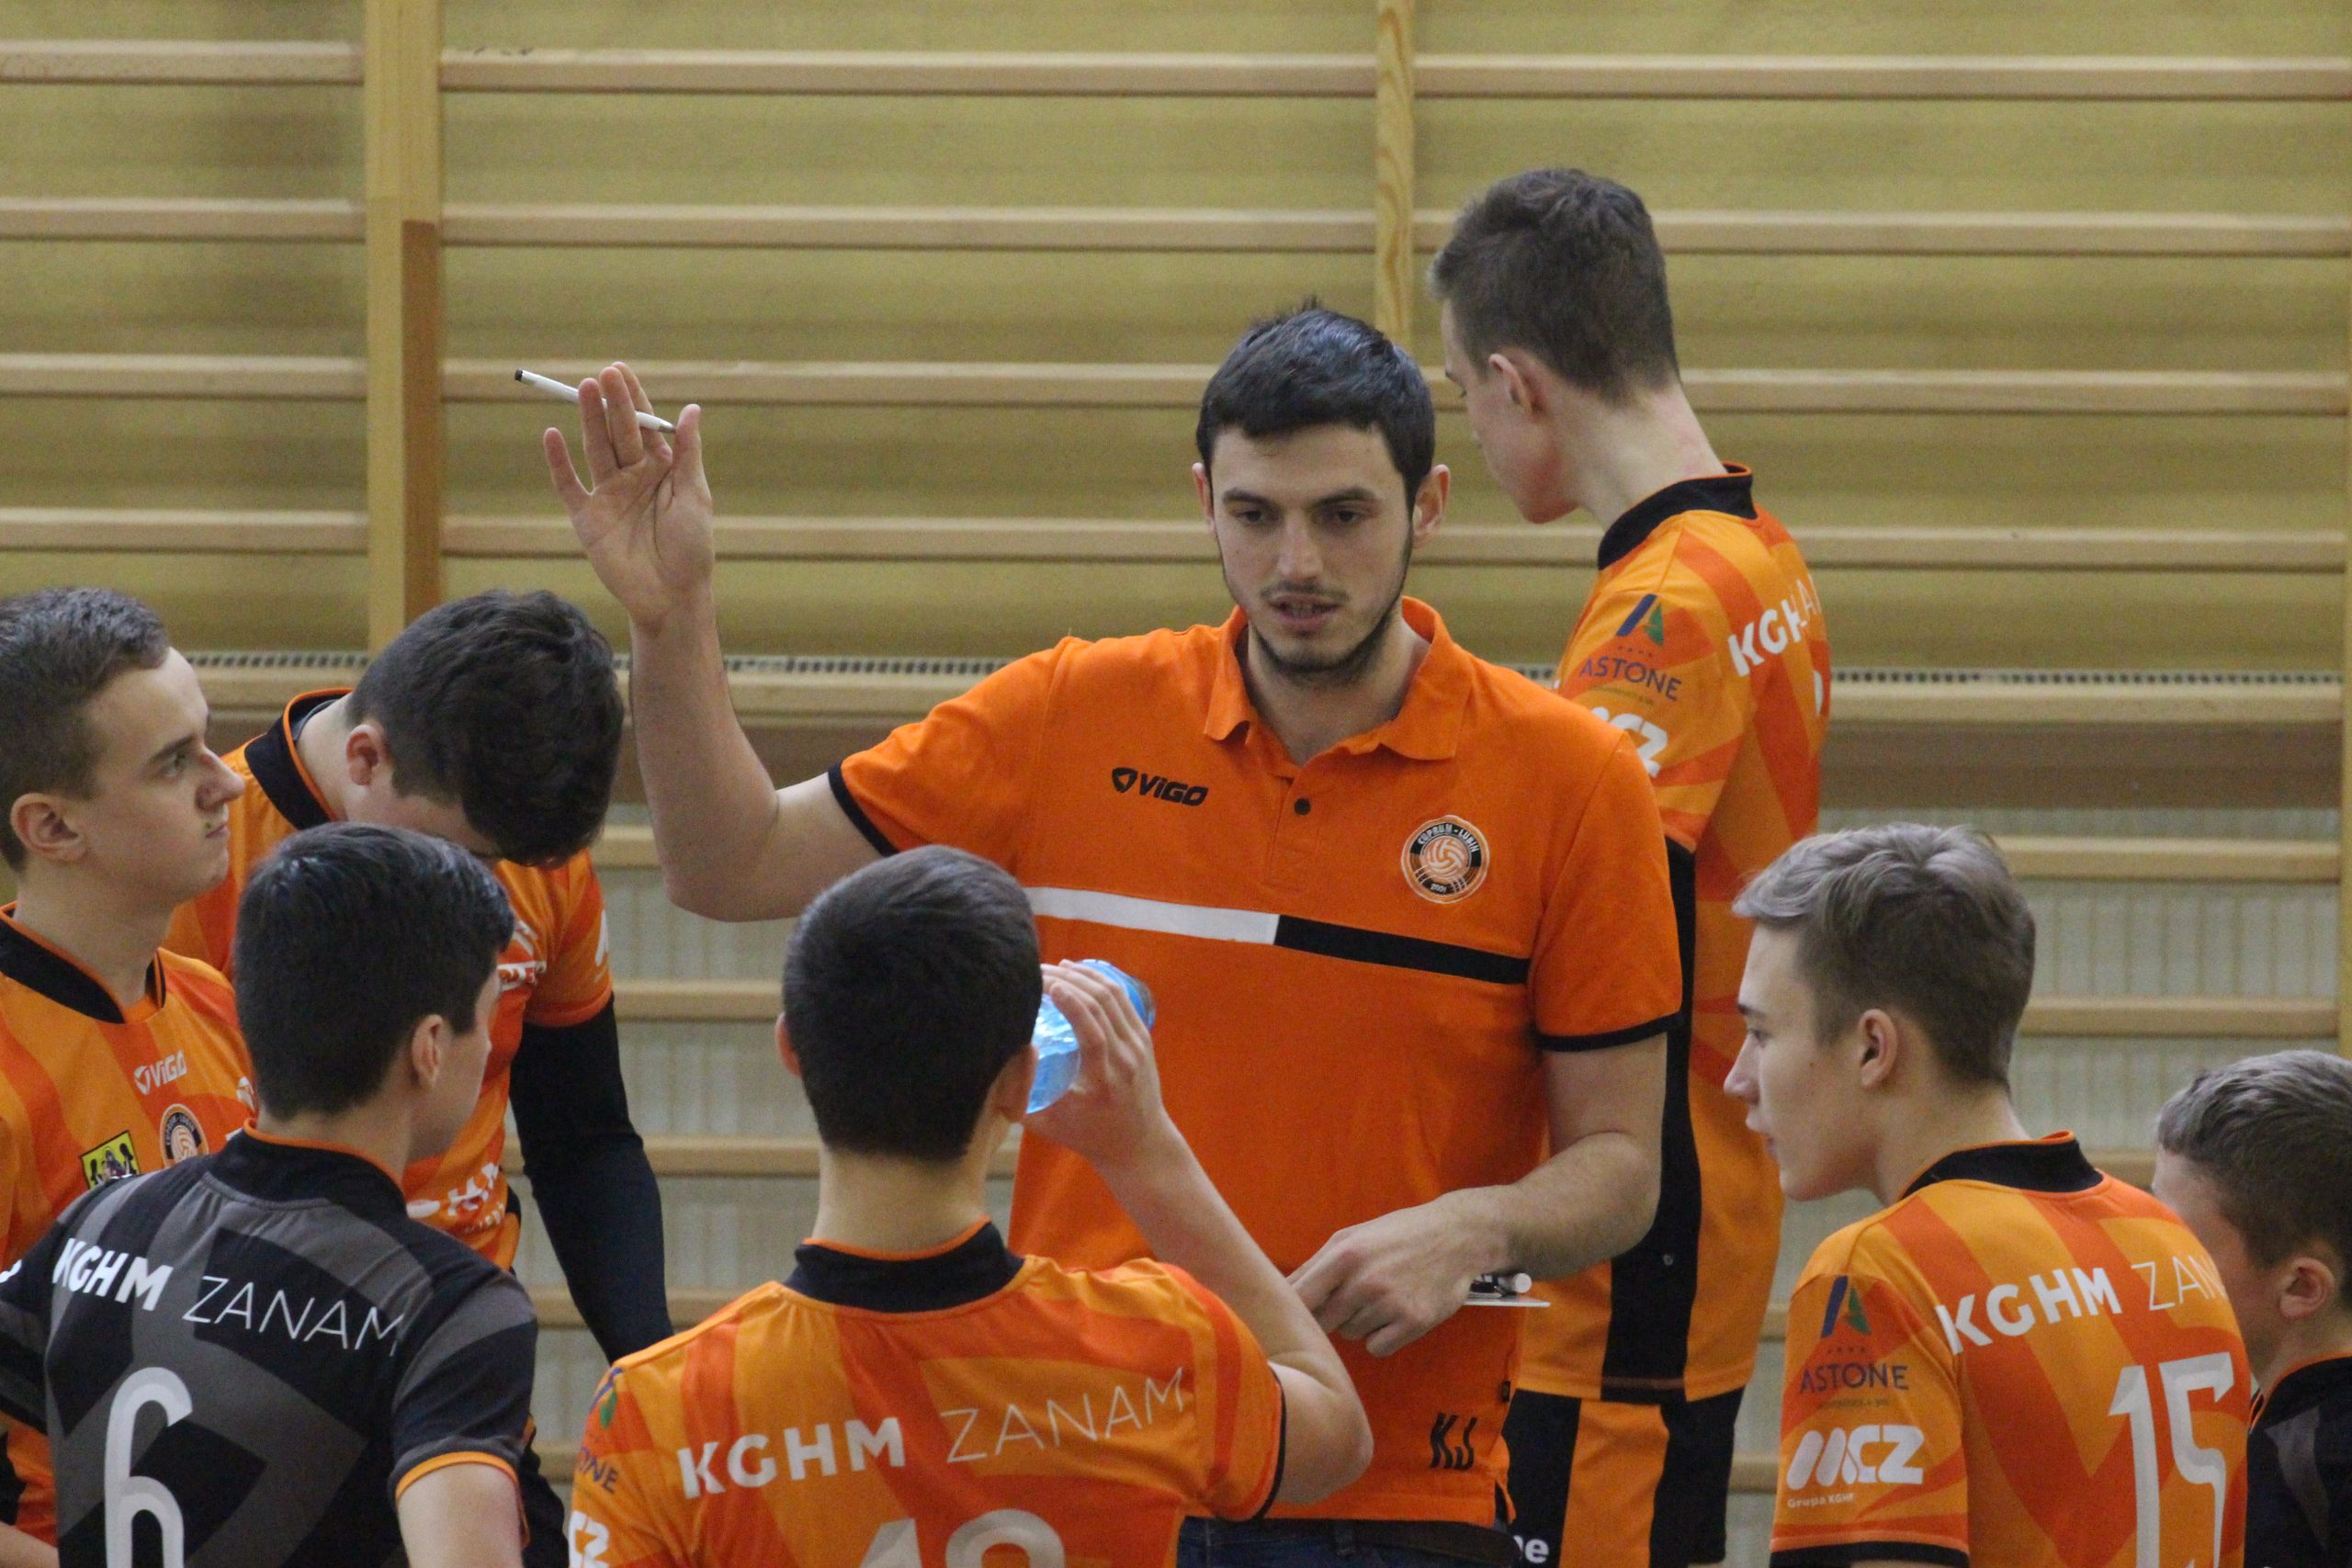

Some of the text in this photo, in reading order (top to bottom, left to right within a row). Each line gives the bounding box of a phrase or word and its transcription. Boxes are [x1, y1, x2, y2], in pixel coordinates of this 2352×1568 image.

[1579, 656, 1681, 701] ASTONE
[1418, 824, 1453, 844] CUPRUM
[1458, 829, 1480, 852] LUBIN
[52, 1238, 405, 1357] KGHM ZANAM
[1935, 1267, 2122, 1356] KGHM
[1800, 1362, 1909, 1394] ASTONE
[104, 1366, 193, 1568] 6
[677, 1367, 1184, 1499] KGHM ZANAM
[2108, 1351, 2234, 1568] 15
